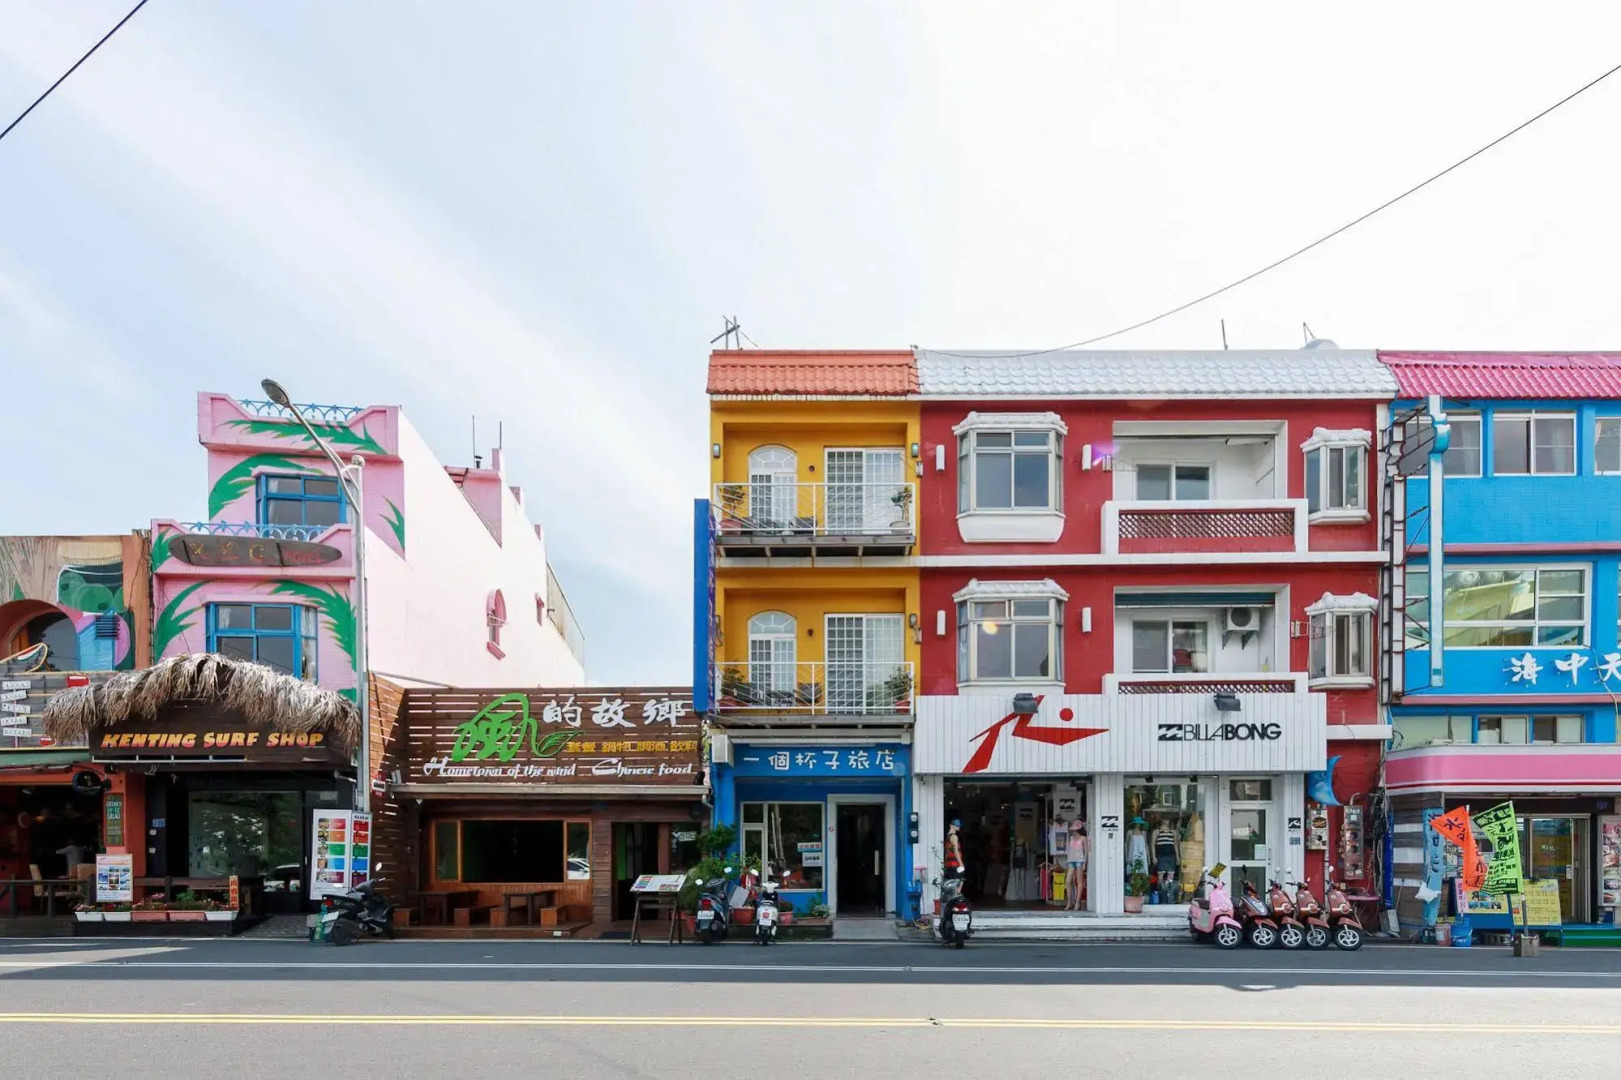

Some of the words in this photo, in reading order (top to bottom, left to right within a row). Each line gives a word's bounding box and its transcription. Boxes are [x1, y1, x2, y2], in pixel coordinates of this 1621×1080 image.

[101, 733, 197, 748] KENTING
[203, 731, 259, 748] SURF
[266, 732, 324, 748] SHOP
[1183, 723, 1282, 741] BILLABONG
[423, 756, 502, 776] Hometown
[507, 763, 521, 779] of
[523, 763, 544, 776] the
[547, 763, 577, 777] wind
[592, 758, 655, 777] Chinese
[658, 762, 692, 776] food
[743, 749, 895, 771] 一個杯子旅店
